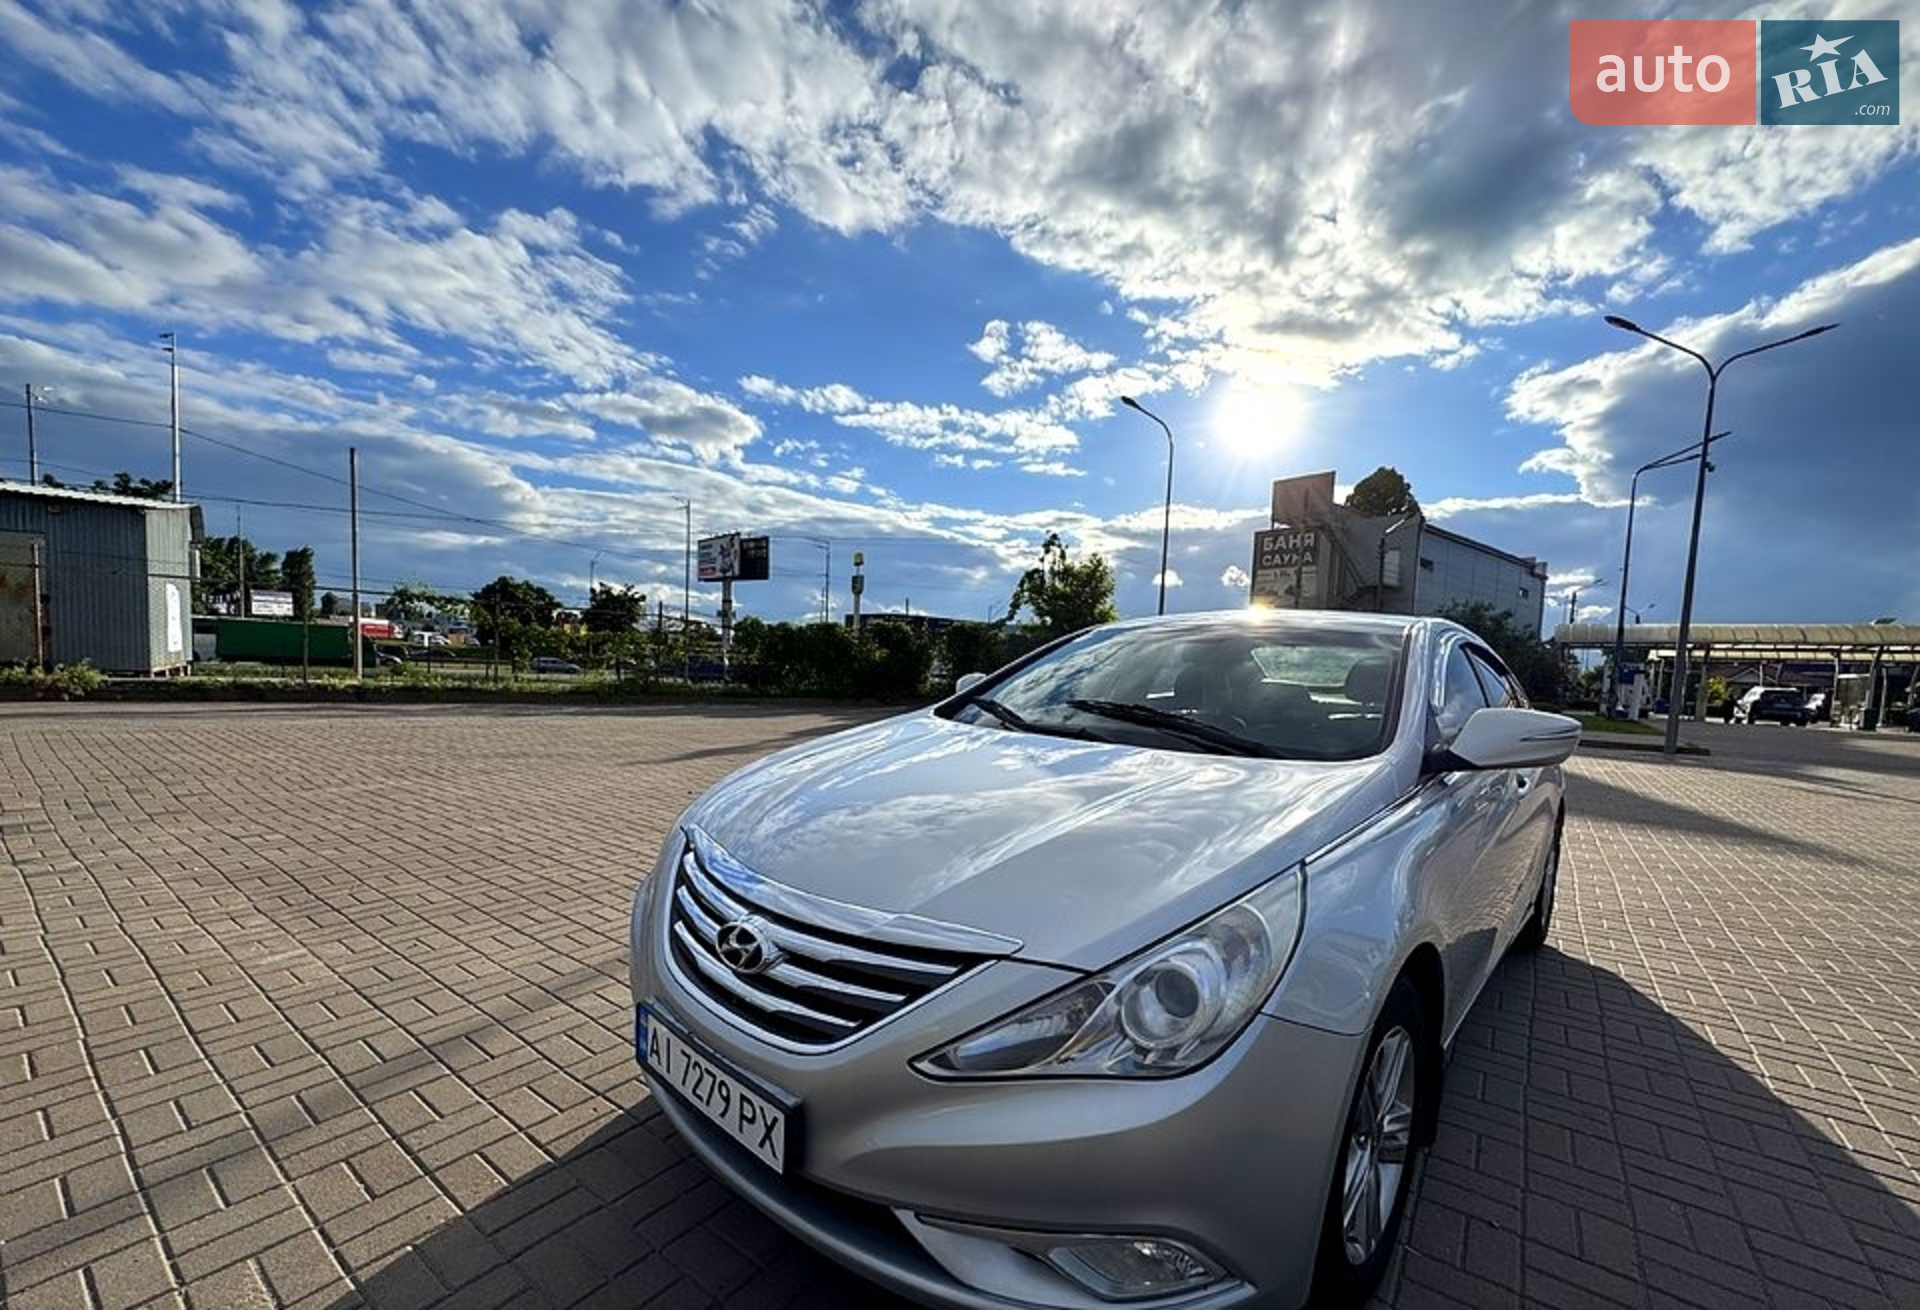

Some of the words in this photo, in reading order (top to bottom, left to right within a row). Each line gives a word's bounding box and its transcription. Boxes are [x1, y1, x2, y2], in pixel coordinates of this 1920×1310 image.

[1263, 532, 1315, 552] БАНЯ
[650, 1026, 671, 1075] AI
[680, 1049, 731, 1119] 7279
[738, 1092, 780, 1161] PX
